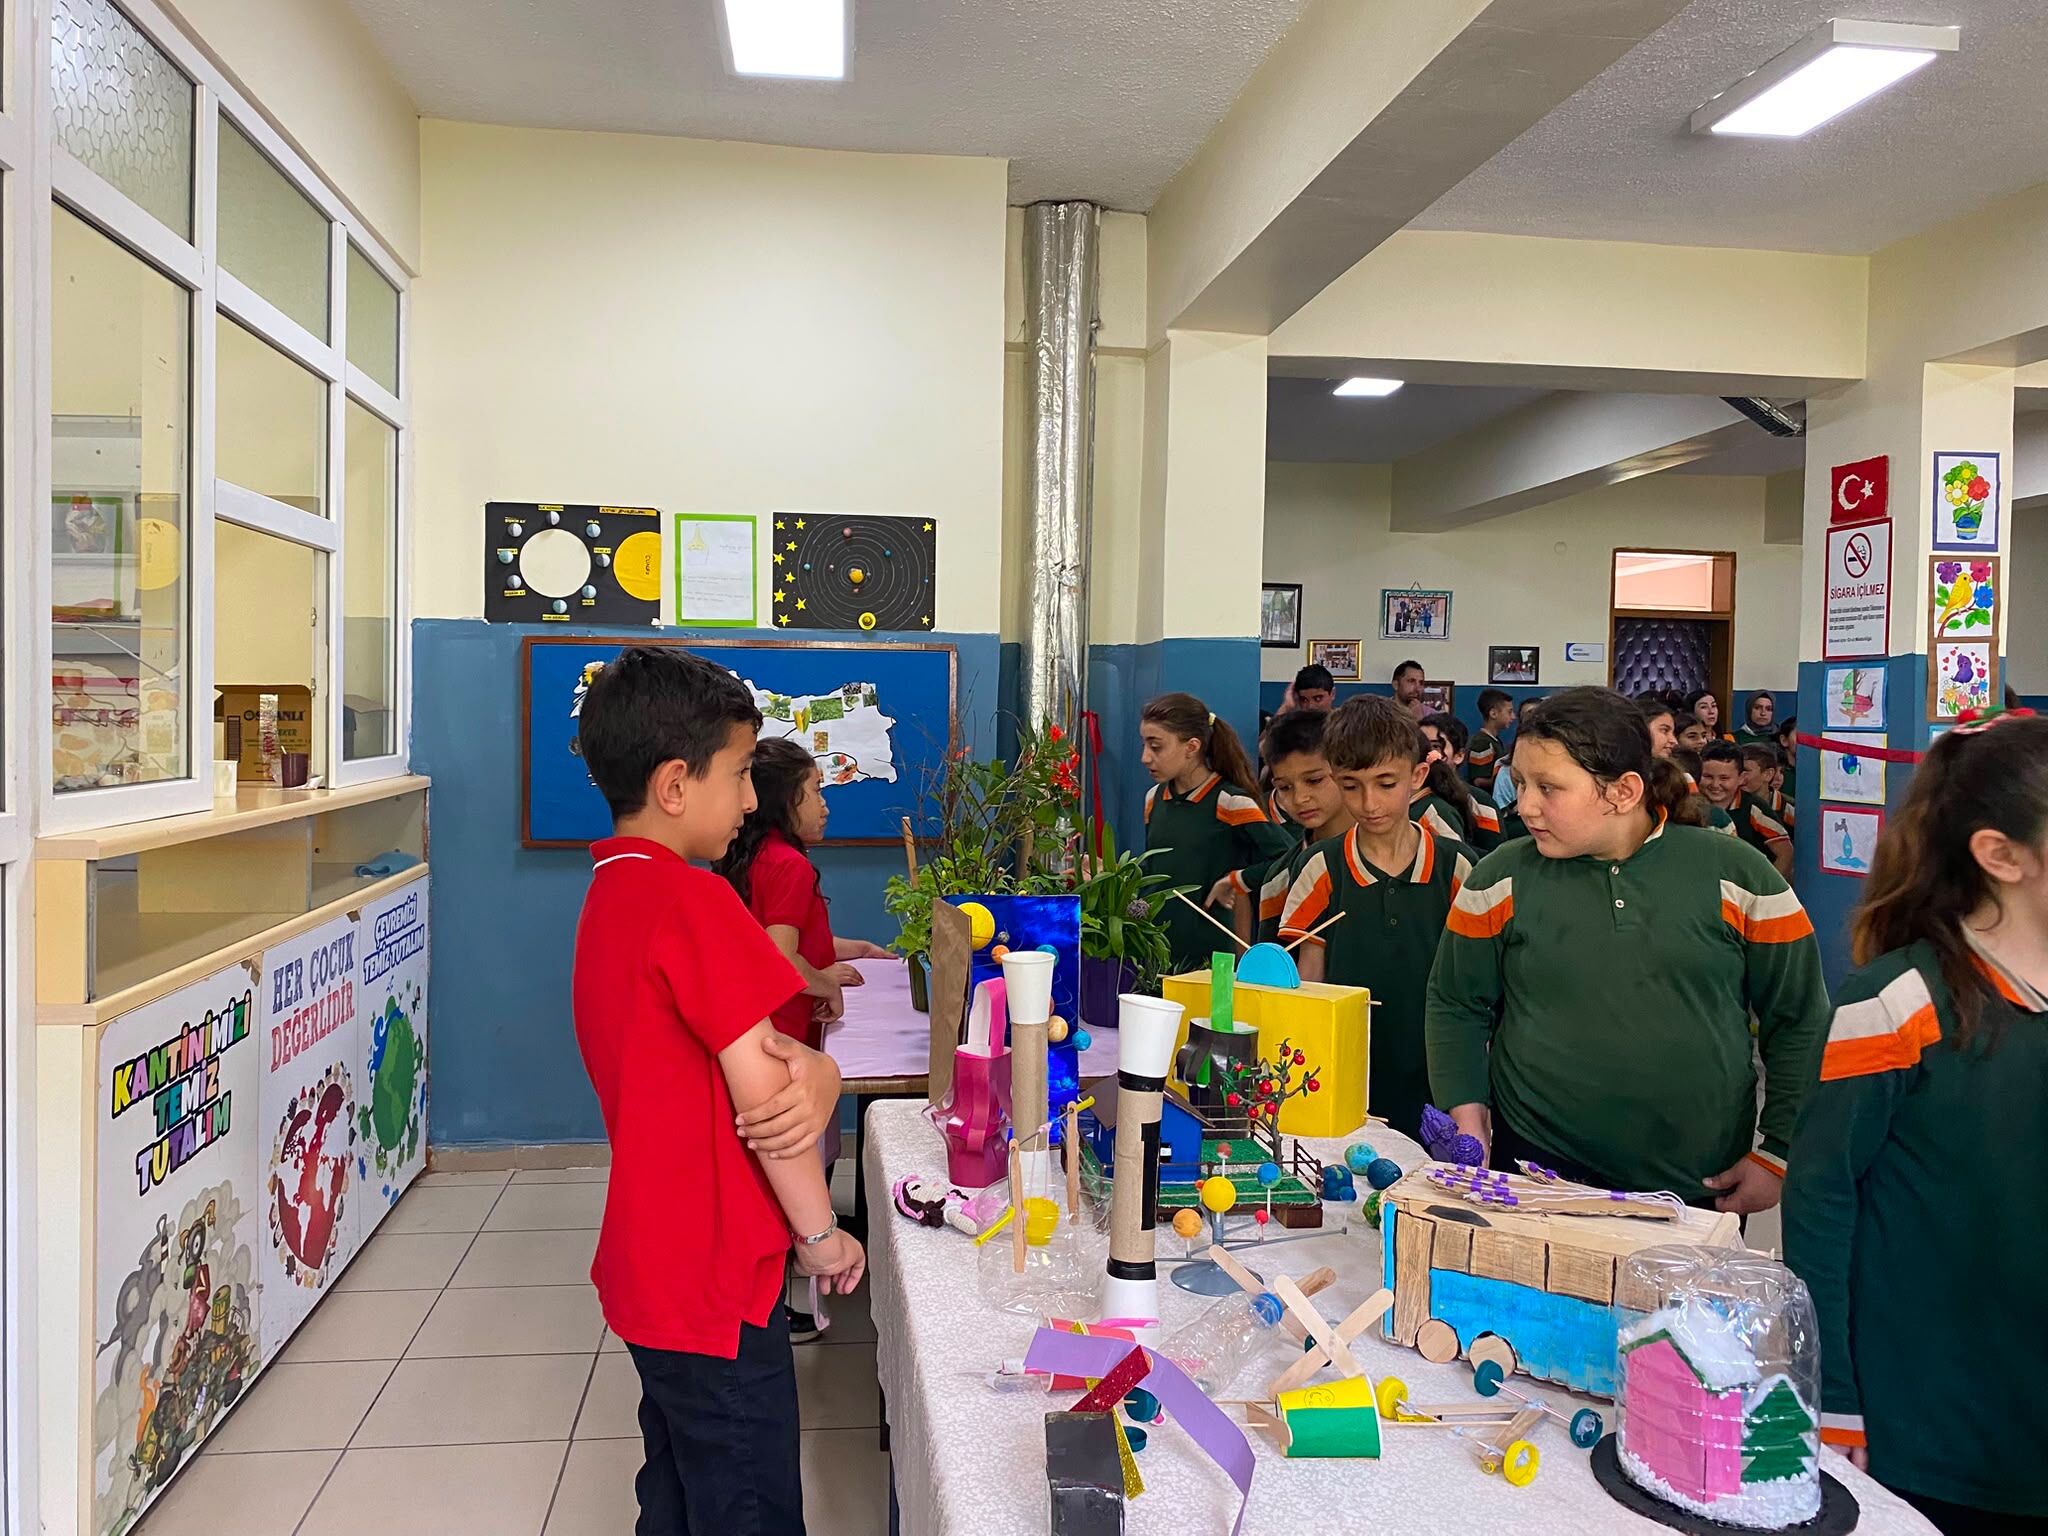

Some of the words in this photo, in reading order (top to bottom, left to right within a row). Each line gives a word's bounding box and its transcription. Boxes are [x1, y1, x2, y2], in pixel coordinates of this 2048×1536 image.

[1830, 585, 1856, 600] SİGARA
[1856, 582, 1885, 600] İÇİLMEZ
[244, 710, 305, 721] OSANLI
[363, 941, 391, 986] TEMİZ
[390, 923, 425, 969] TUTALIM
[374, 892, 418, 950] ÇEVREMİZİ
[272, 957, 303, 1014] HER
[310, 930, 355, 998] ÇOCUK
[111, 988, 252, 1120] KANTİNİMİZİ
[271, 976, 355, 1074] DEĞERLİDİR
[153, 1056, 220, 1138] TEMİZ
[136, 1090, 232, 1197] TUTALIM
